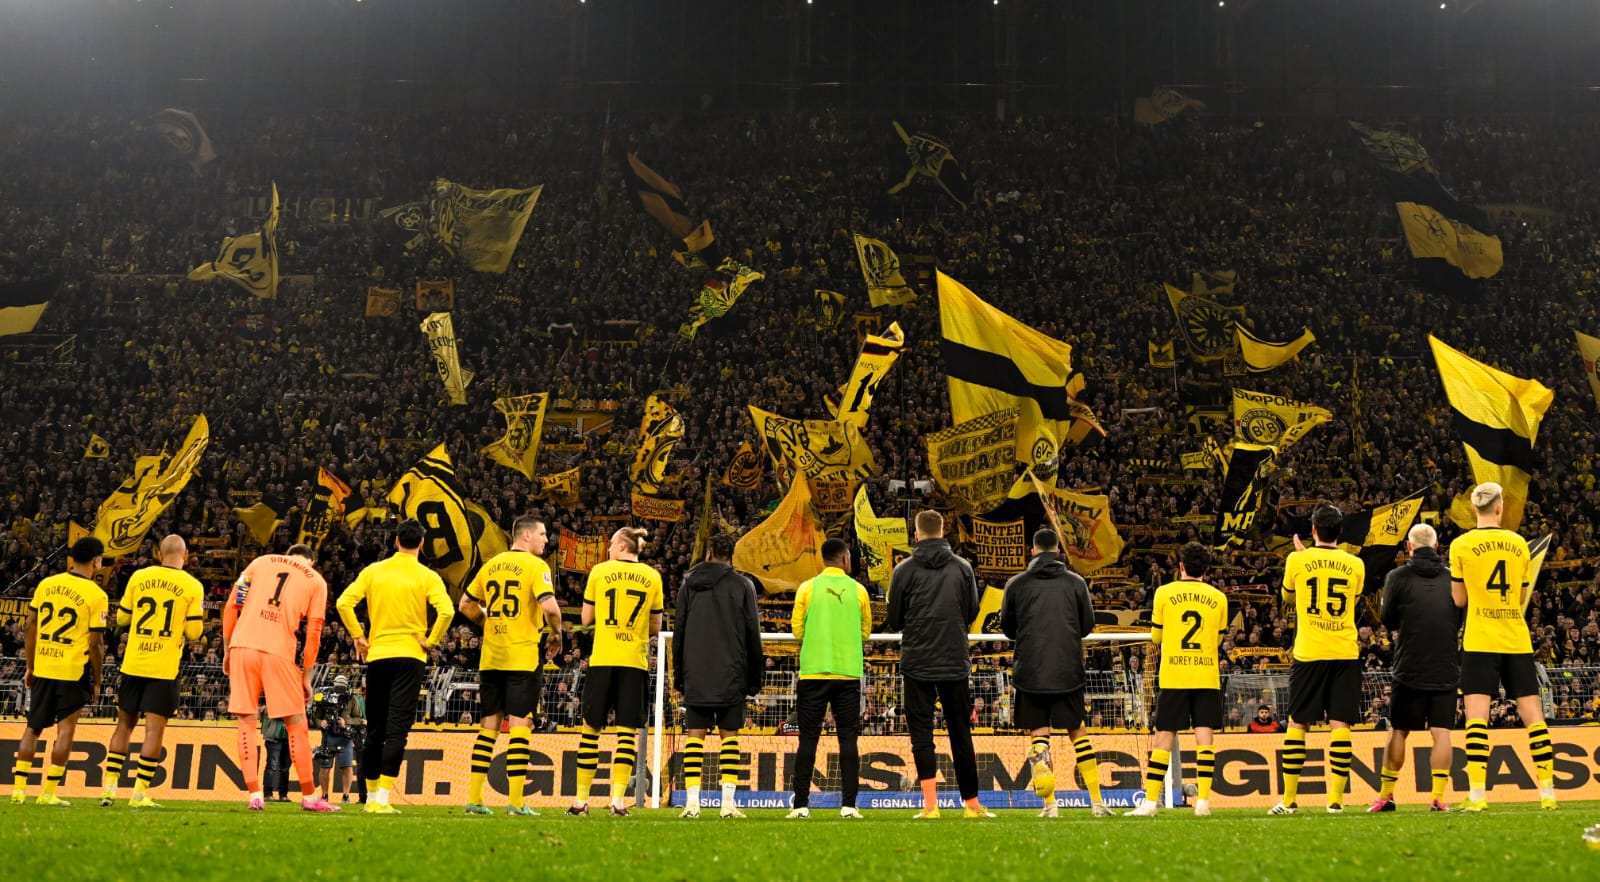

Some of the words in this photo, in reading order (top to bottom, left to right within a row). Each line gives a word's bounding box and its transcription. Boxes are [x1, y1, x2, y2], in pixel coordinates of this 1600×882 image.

[975, 522, 1023, 536] UNITED
[991, 536, 1023, 545] STAND
[1472, 541, 1522, 558] DORTMUND
[488, 562, 522, 577] DORTMUND
[995, 557, 1023, 568] FALL
[1305, 559, 1353, 576] DORTMUND
[139, 579, 184, 597] DORTMUND
[605, 571, 651, 588] DORTMUND
[1486, 559, 1511, 602] 4
[46, 585, 85, 607] DORTMUND
[268, 572, 290, 607] 1
[1306, 576, 1348, 617] 15
[486, 579, 521, 618] 25
[1169, 592, 1218, 609] DORTMUND
[605, 588, 647, 627] 17
[40, 602, 77, 645] 22
[136, 596, 176, 638] 21
[1181, 610, 1202, 650] 2
[747, 799, 785, 808] IDUNA
[871, 798, 919, 808] SIGNAL
